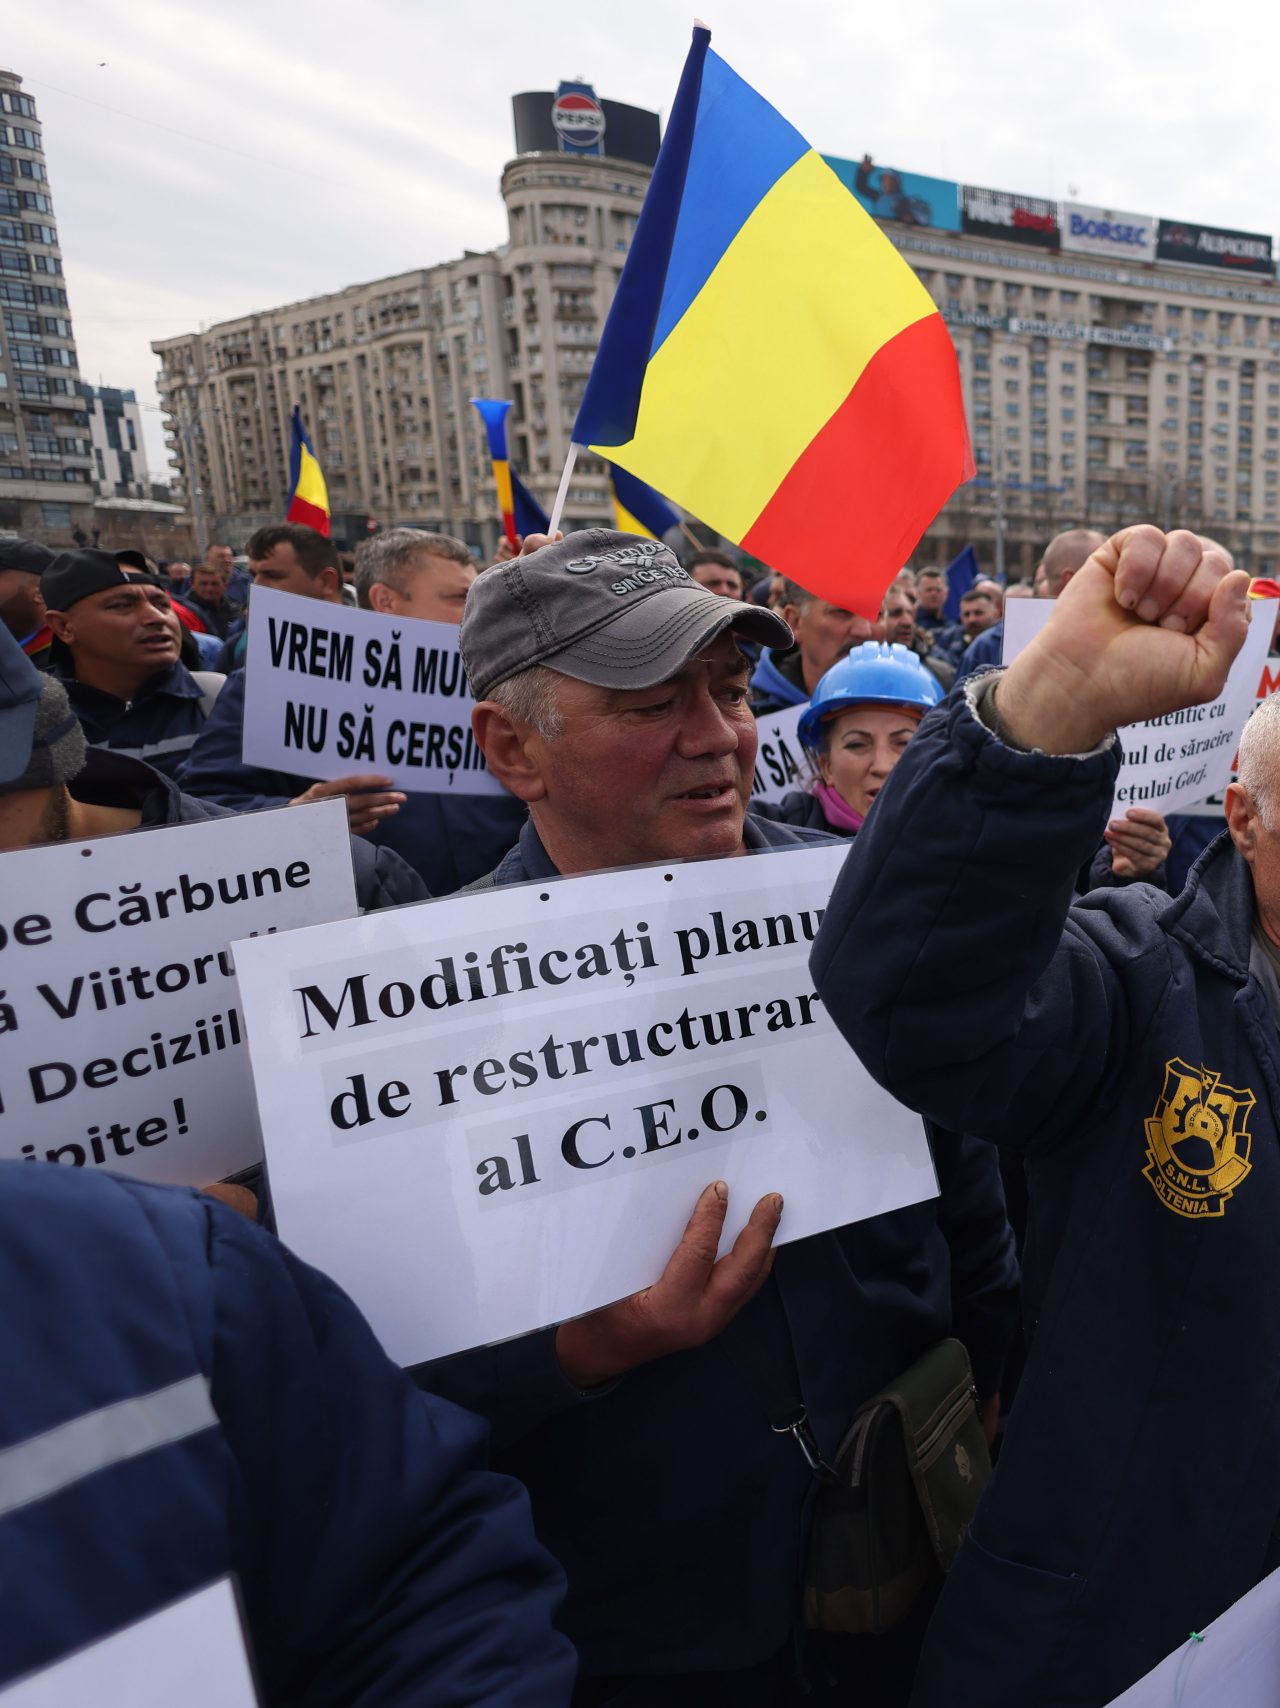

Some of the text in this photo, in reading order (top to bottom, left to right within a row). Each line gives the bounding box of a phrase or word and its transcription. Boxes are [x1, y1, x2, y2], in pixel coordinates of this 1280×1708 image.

[1069, 213, 1148, 247] BORSEC
[611, 569, 665, 595] SINCE
[268, 617, 354, 683] VREM
[363, 630, 402, 691] SĂ
[284, 701, 328, 753] NU
[336, 703, 375, 762] SĂ
[1209, 703, 1226, 720] cu
[1154, 743, 1176, 763] de
[1180, 728, 1233, 758] săracire
[75, 861, 311, 933] Cărbune
[293, 921, 660, 1039] Modificați
[28, 1008, 244, 1104] Deciziil
[329, 1073, 412, 1132] de
[474, 1083, 769, 1196] al C.E.O.
[1155, 1176, 1210, 1213] OLTENIA
